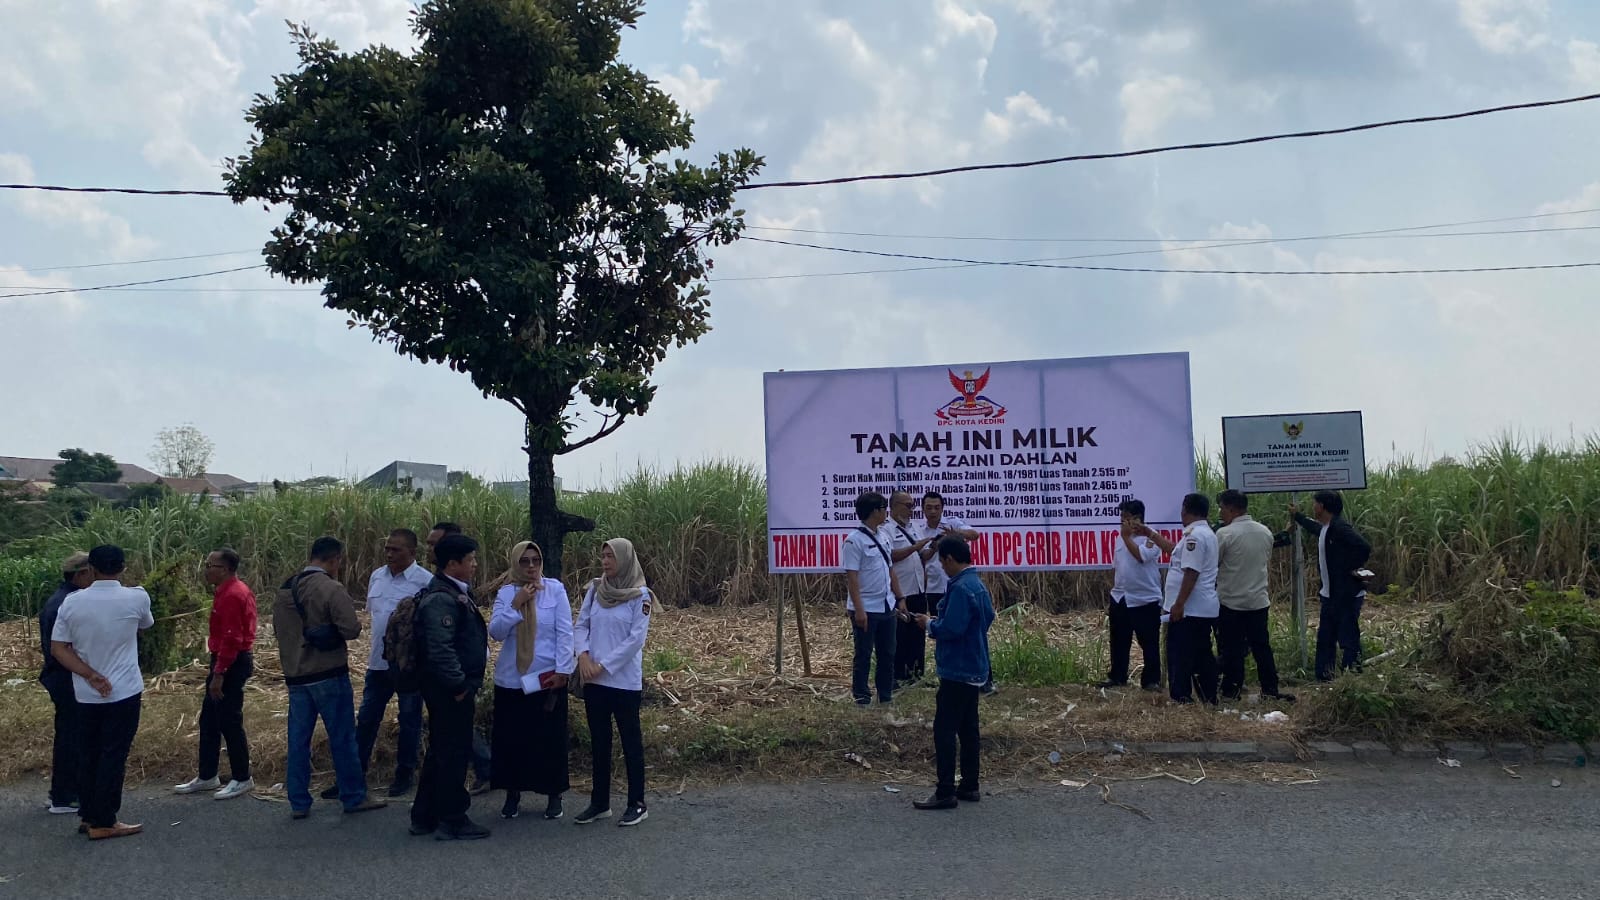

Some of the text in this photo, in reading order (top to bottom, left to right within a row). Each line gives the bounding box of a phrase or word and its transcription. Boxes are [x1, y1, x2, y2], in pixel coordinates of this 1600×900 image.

[850, 426, 1098, 454] TANAH INI MILIK
[871, 451, 1077, 469] H. ABAS ZAINI DAHLAN
[1241, 451, 1295, 459] PEMERINTAH
[821, 475, 828, 484] 1.
[832, 473, 857, 483] Surat
[857, 473, 874, 482] Hak
[874, 472, 897, 482] Milik
[924, 471, 940, 481] a/n
[941, 471, 963, 481] Abas
[964, 470, 986, 480] Zaini
[987, 470, 1001, 480] No.
[1003, 469, 1037, 479] 18/1981
[1039, 468, 1060, 479] Luas
[1062, 468, 1090, 478] Tanah
[1091, 467, 1115, 477] 2.515
[821, 487, 829, 496] 2.
[833, 486, 856, 496] Surat
[941, 484, 963, 494] Abas
[964, 483, 986, 493] Zaini
[988, 483, 1002, 493] No.
[1004, 482, 1038, 492] 19/1981
[1040, 481, 1061, 492] Luas
[1062, 480, 1090, 491] Tanah
[1091, 480, 1118, 491] 2.465
[822, 499, 829, 509] 3.
[833, 498, 856, 508] Surat
[943, 497, 964, 507] Abas
[965, 496, 987, 506] Zaini
[988, 496, 1002, 506] No.
[1003, 495, 1040, 505] 20/1981
[1041, 494, 1062, 505] Luas
[1064, 494, 1092, 504] Tanah
[1093, 493, 1120, 503] 2.505
[822, 512, 830, 521] 4.
[833, 511, 856, 521] Surat
[966, 509, 987, 519] Zaini
[989, 509, 1003, 519] No.
[1004, 508, 1040, 518] 67/1982
[1042, 507, 1063, 518] Luas
[1065, 507, 1093, 517] Tanah
[1094, 506, 1120, 517] 2.450
[773, 534, 817, 568] TANAH
[820, 533, 839, 567] INI
[993, 531, 1022, 566] DPC
[1025, 530, 1062, 566] GRIB
[1065, 530, 1099, 565] JAYA
